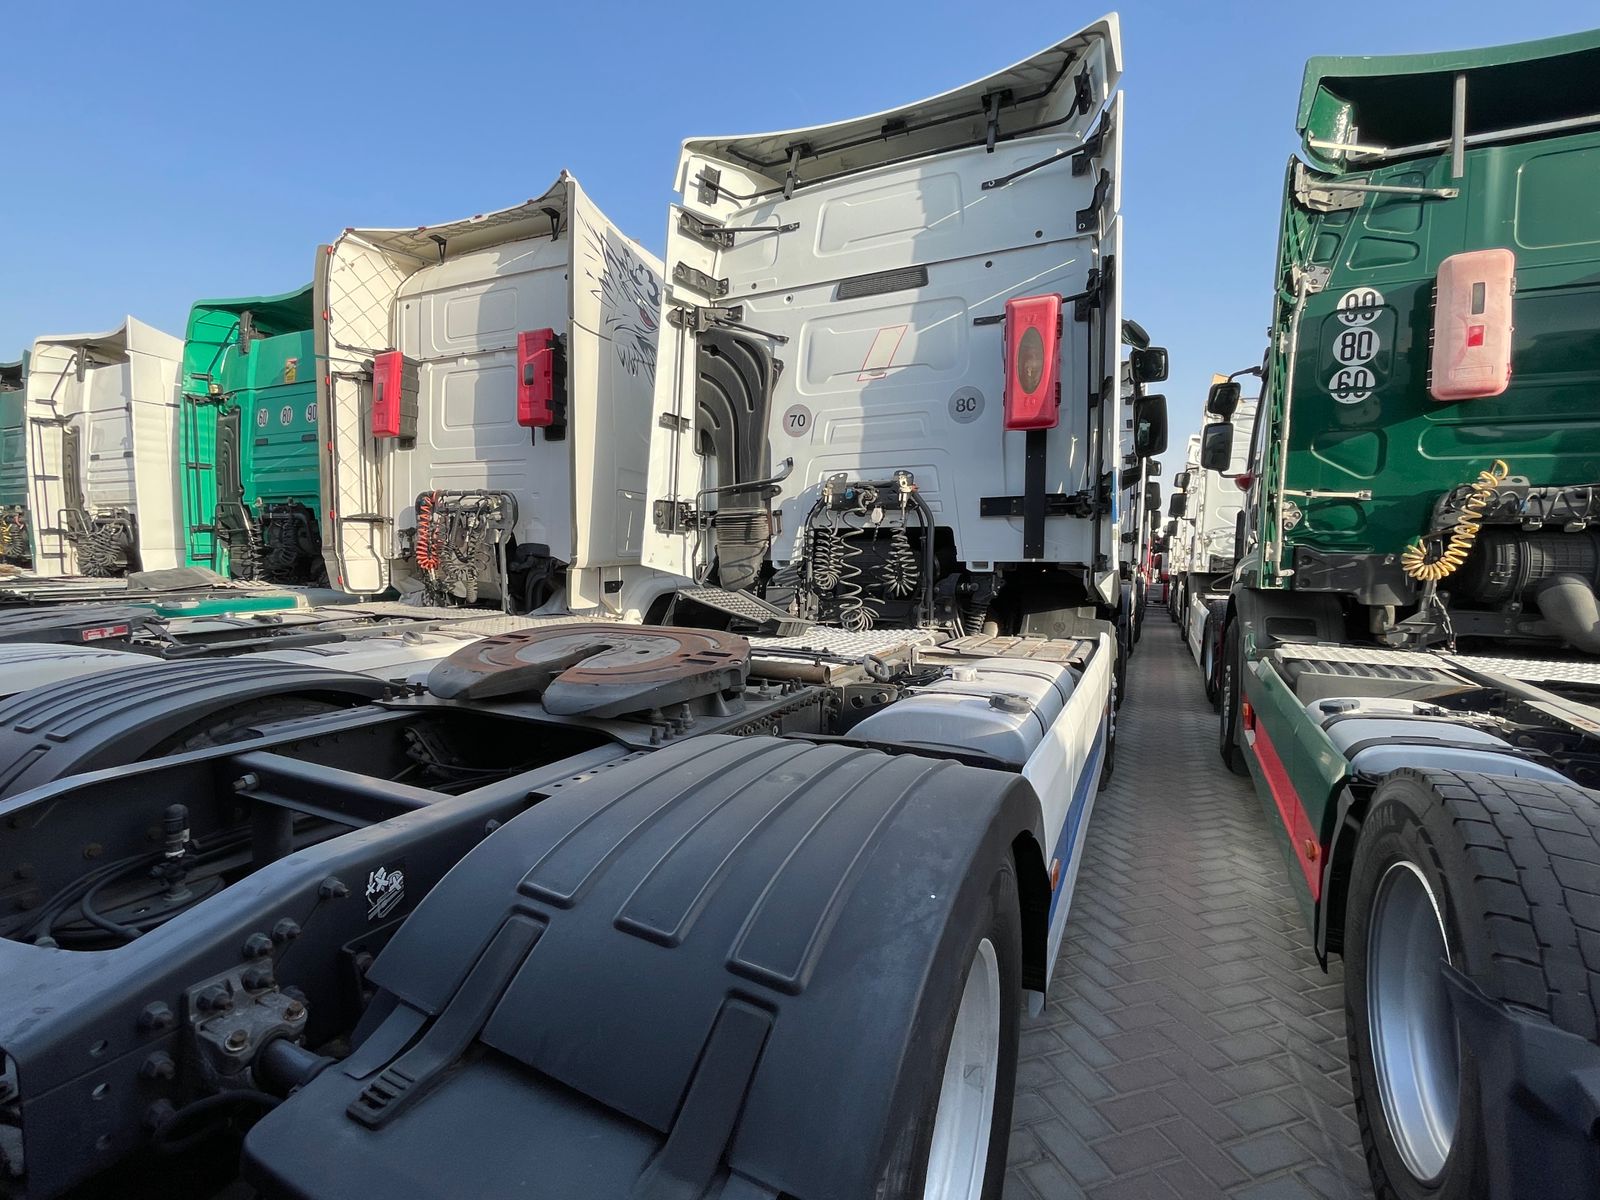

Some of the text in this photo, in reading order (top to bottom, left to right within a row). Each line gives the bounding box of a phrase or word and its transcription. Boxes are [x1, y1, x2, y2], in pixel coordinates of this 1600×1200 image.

[1340, 330, 1373, 362] 80
[1337, 369, 1368, 399] 60
[956, 397, 976, 412] 80
[283, 408, 292, 423] 80
[308, 405, 317, 421] 90
[789, 414, 806, 427] 70
